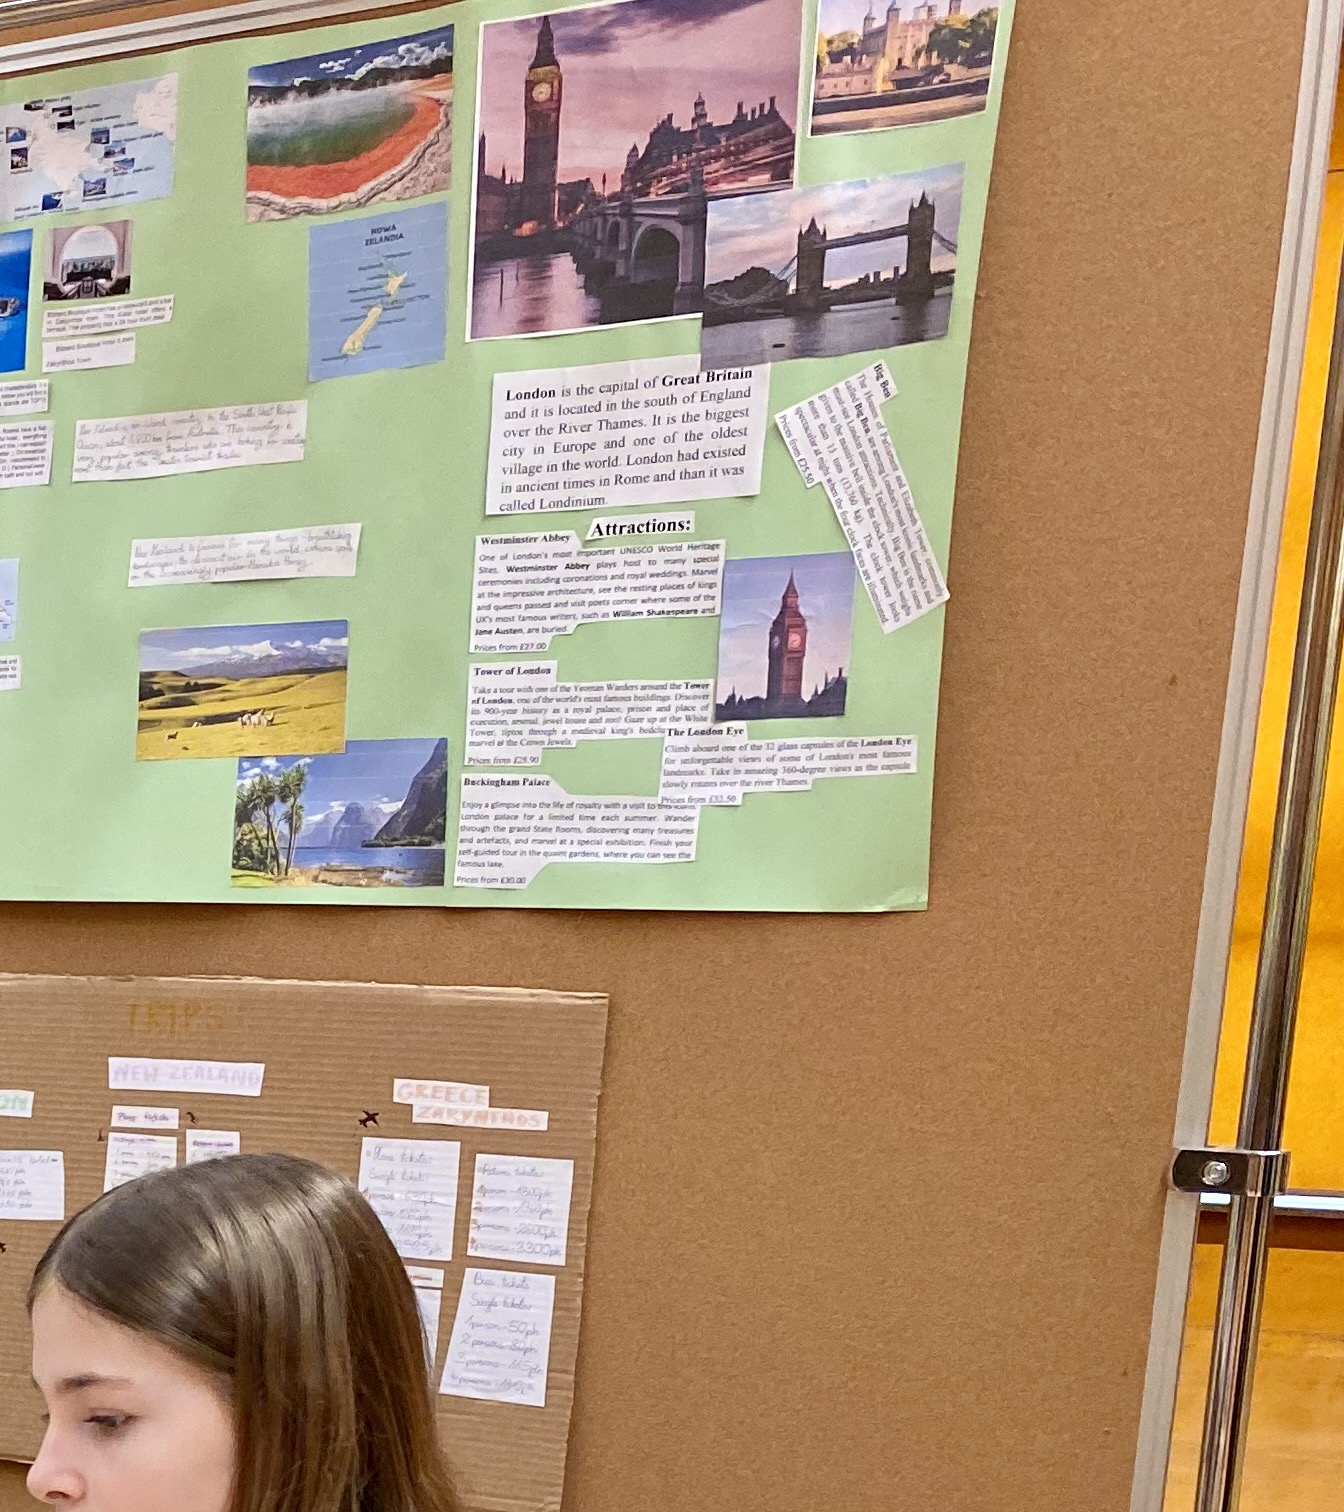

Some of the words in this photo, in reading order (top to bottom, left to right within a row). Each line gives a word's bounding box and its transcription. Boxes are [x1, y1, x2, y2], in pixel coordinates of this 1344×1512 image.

[506, 388, 556, 401] London
[561, 385, 571, 397] is
[576, 384, 594, 396] the
[599, 378, 639, 395] capital
[643, 376, 659, 388] of
[662, 374, 700, 387] Great
[706, 367, 753, 383] Britain
[873, 363, 884, 382] Big
[879, 382, 891, 399] Ben
[504, 407, 526, 420] and
[531, 408, 538, 418] it
[544, 408, 554, 417] is
[558, 401, 602, 416] located
[606, 401, 617, 412] in
[621, 398, 640, 410] the
[644, 394, 677, 408] south
[682, 391, 698, 404] of
[700, 386, 751, 404] England
[503, 428, 530, 438] over
[535, 424, 554, 436] the
[558, 423, 593, 435] River
[597, 418, 647, 431] Thames.
[652, 414, 661, 426] It
[667, 415, 676, 425] is
[681, 411, 700, 423] the
[705, 407, 750, 423] biggest
[502, 446, 525, 459] city
[533, 445, 544, 455] in
[553, 441, 596, 454] Europe
[604, 436, 625, 449] and
[633, 436, 656, 447] one
[663, 431, 678, 444] of
[684, 430, 704, 442] the
[711, 426, 748, 440] oldest
[778, 414, 793, 437] Prices
[790, 436, 801, 454] from
[502, 463, 543, 476] village
[546, 462, 558, 472] in
[562, 459, 580, 472] the
[584, 455, 621, 469] world.
[626, 452, 673, 466] London
[677, 448, 699, 462] had
[703, 444, 746, 459] existed
[500, 483, 512, 494] in
[515, 480, 559, 493] ancient
[563, 478, 595, 490] times
[599, 475, 610, 487] in
[614, 473, 650, 485] Rome
[653, 469, 676, 482] and
[679, 468, 705, 480] than
[709, 466, 717, 478] it
[721, 466, 745, 476] was
[499, 498, 535, 512] called
[539, 496, 608, 510] Londinium.
[591, 518, 691, 537] Attractions:
[480, 535, 538, 545] Westminster
[541, 534, 570, 543] Abbey
[513, 552, 548, 560] London's
[553, 551, 573, 559] most
[576, 549, 615, 558] important
[620, 546, 653, 555] UNESCO
[658, 544, 683, 553] World
[687, 542, 721, 551] Heritage
[474, 644, 497, 652] Prices
[499, 643, 518, 651] from
[473, 667, 503, 676] Tower
[505, 666, 515, 675] of
[516, 666, 552, 675] London
[667, 728, 685, 737] The
[687, 727, 724, 737] London
[726, 726, 745, 737] Eye
[463, 778, 520, 788] Buckingham
[522, 777, 551, 786] Palace
[661, 796, 685, 804] Prices
[688, 795, 706, 803] from
[456, 876, 479, 884] Prices
[480, 876, 499, 884] from
[113, 1064, 159, 1083] NEW
[169, 1066, 261, 1085] ZEALAND
[397, 1083, 488, 1105] GREECE
[416, 1105, 542, 1128] ZAKYNTHOS
